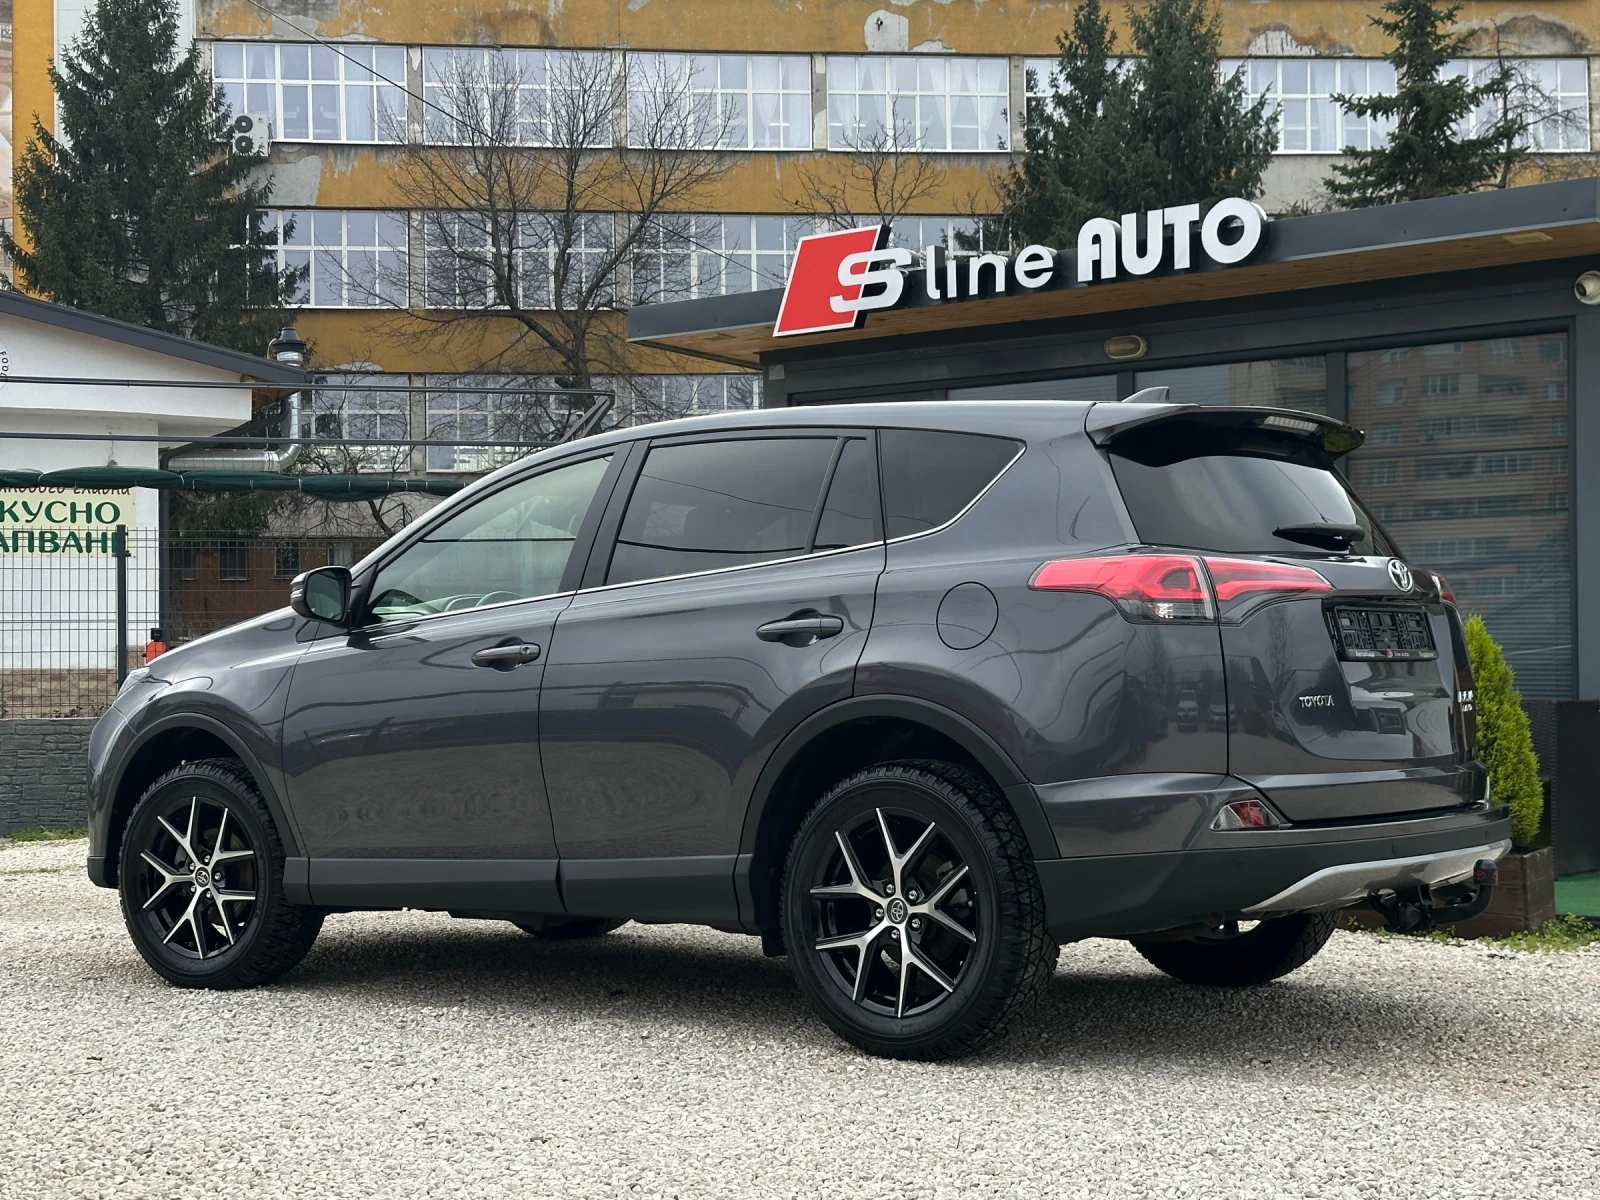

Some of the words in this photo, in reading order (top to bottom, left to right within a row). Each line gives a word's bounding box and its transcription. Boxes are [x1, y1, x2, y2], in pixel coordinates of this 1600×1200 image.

[829, 247, 912, 314] S
[926, 244, 1055, 300] line
[1077, 197, 1262, 283] AUTO
[0, 350, 9, 376] FOO
[1298, 695, 1335, 708] TOYOTA
